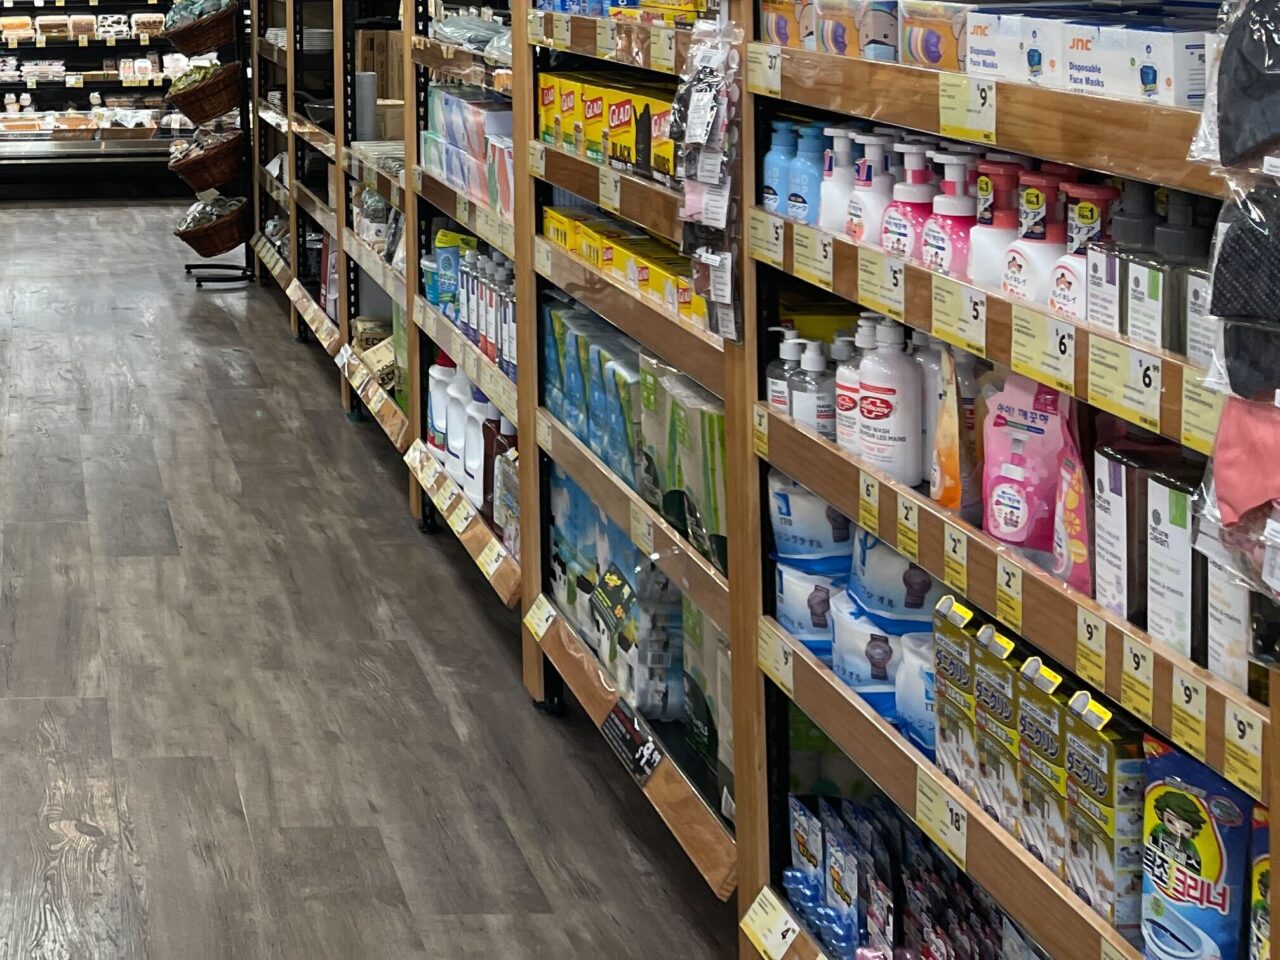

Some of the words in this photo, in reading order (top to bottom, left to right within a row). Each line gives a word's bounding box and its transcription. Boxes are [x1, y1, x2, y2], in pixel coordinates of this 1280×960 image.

[1068, 61, 1102, 74] Disposable
[1069, 74, 1083, 86] Face
[1084, 75, 1104, 87] Masks
[561, 94, 575, 109] GLAD
[585, 101, 603, 118] GLAD
[609, 105, 631, 128] GLAD
[1149, 525, 1169, 539] nature
[1149, 532, 1170, 549] clean
